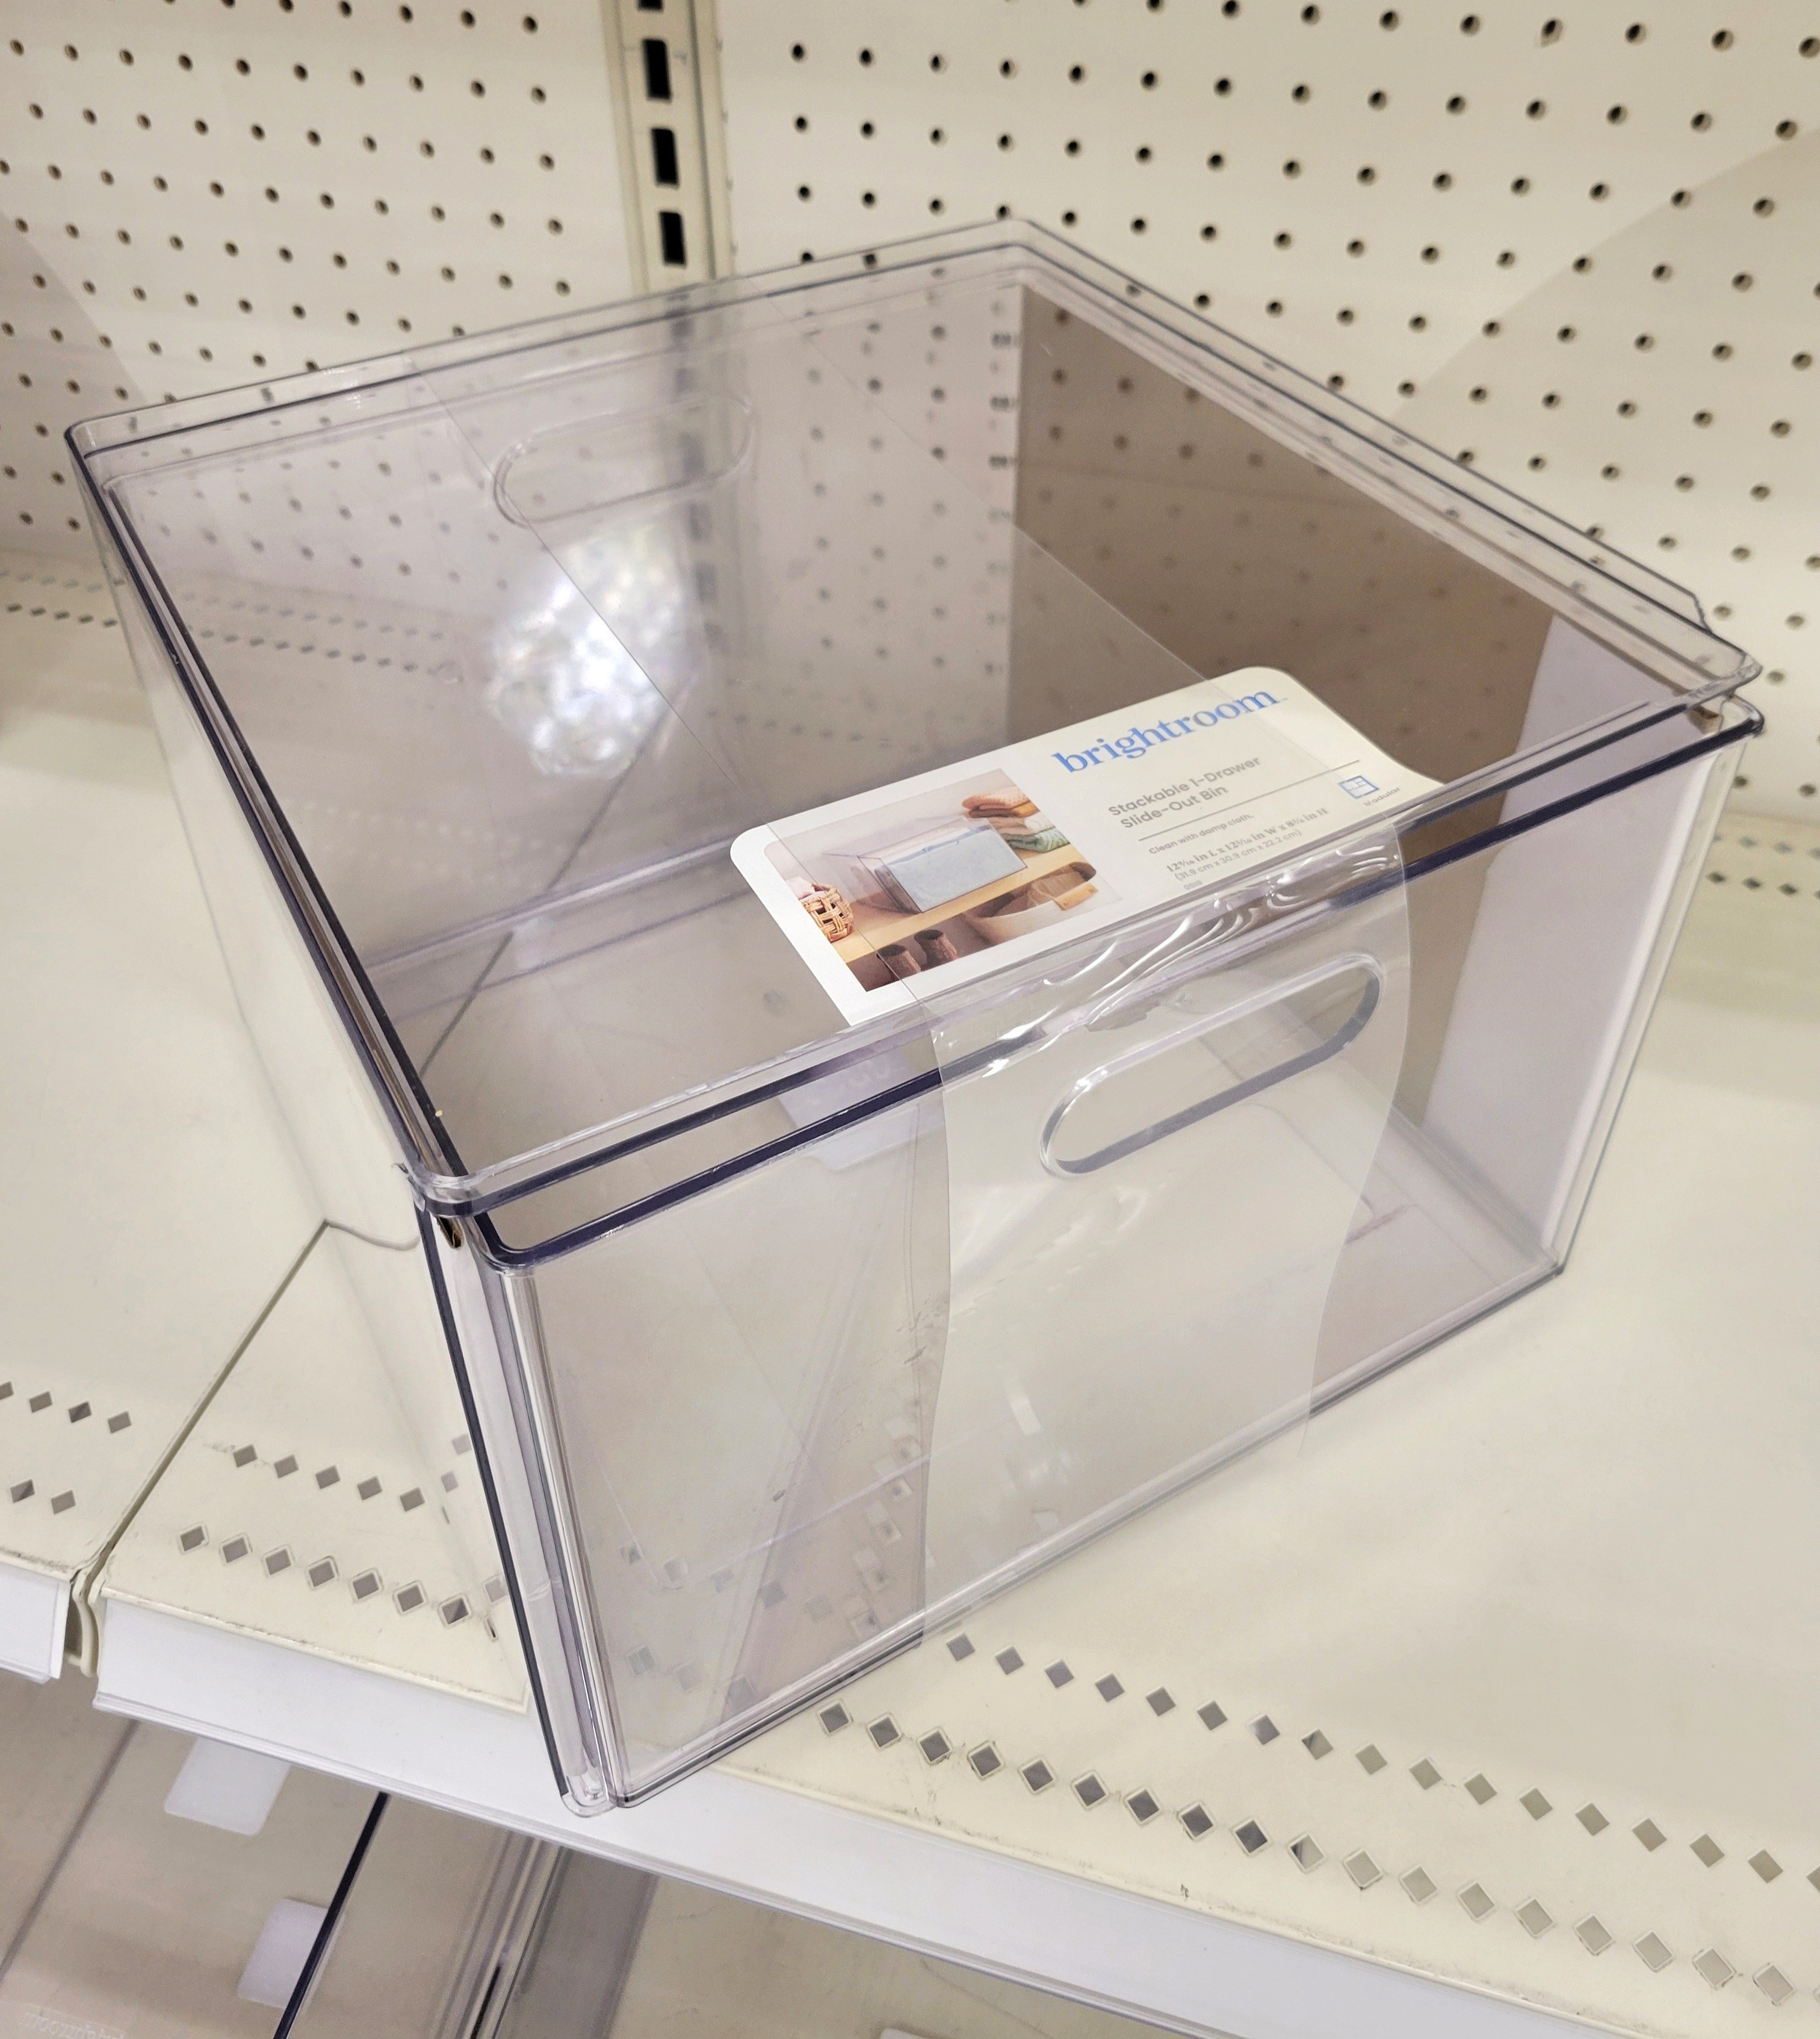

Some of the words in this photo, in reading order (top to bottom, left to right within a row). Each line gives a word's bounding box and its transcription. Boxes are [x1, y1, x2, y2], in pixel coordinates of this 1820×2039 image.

[1051, 690, 1281, 773] brightroom
[1108, 784, 1189, 815] Stackable
[1189, 757, 1260, 787] 1-Drawer
[1120, 795, 1201, 828] Slide-Out
[1199, 785, 1228, 801] Bin
[1363, 787, 1400, 806] Modular
[1149, 840, 1177, 854] Clean
[1177, 834, 1199, 844] with
[1199, 823, 1227, 836] damp
[1227, 814, 1254, 826] cloth.
[1174, 868, 1196, 881] (31.9
[1198, 863, 1214, 872] cm
[1219, 853, 1240, 864] 30.9
[1241, 847, 1257, 856] cm
[1262, 837, 1283, 847] 22.2
[1283, 829, 1302, 840] cm)
[1193, 853, 1209, 862] in
[1251, 832, 1266, 841] in
[1264, 826, 1277, 835] W
